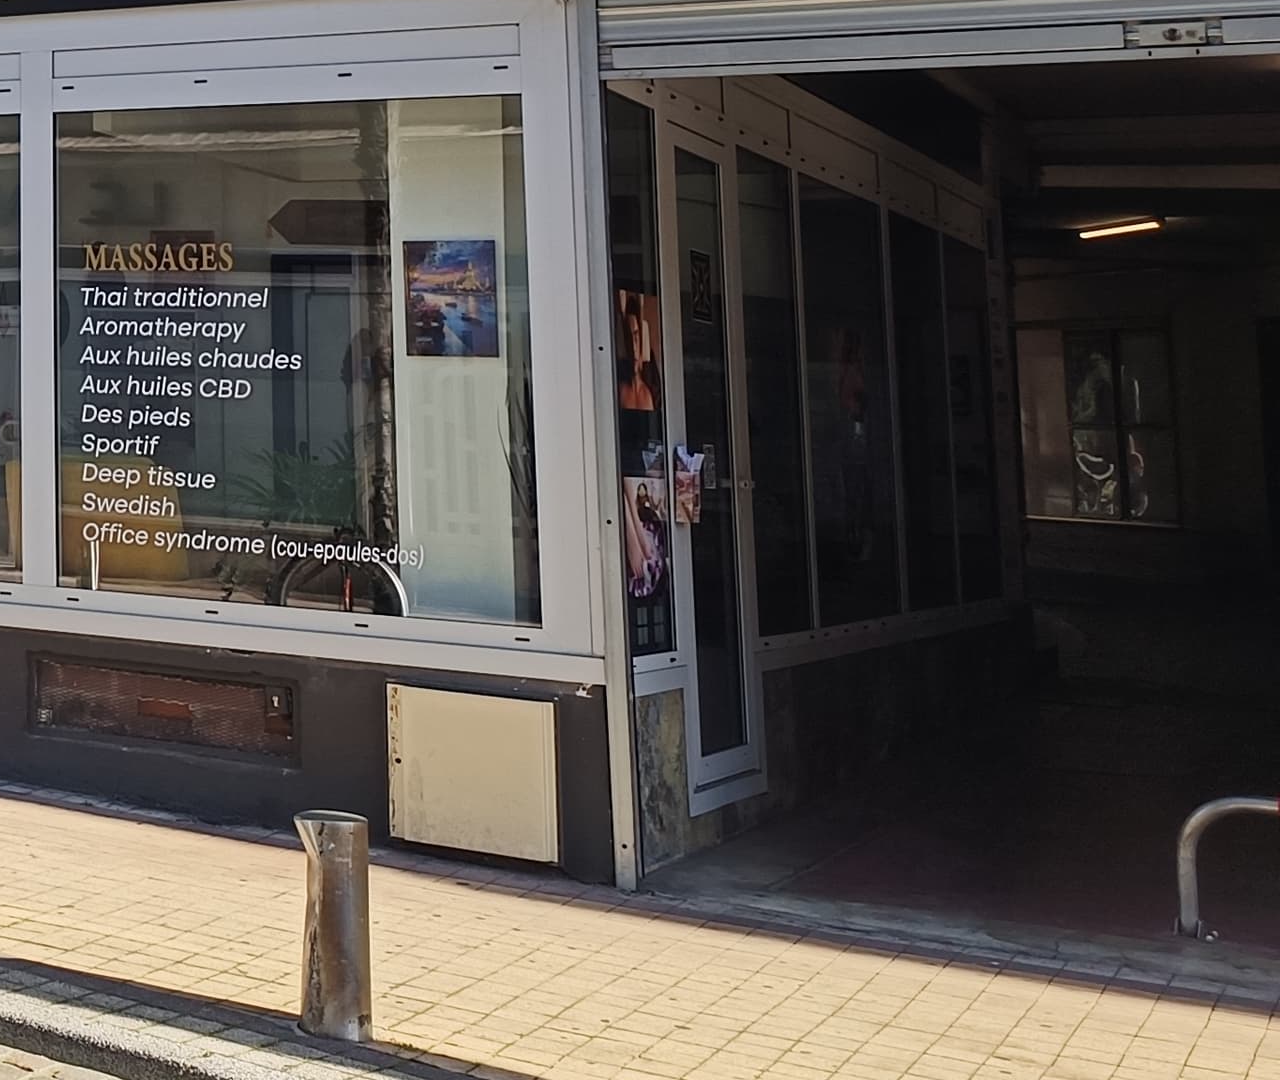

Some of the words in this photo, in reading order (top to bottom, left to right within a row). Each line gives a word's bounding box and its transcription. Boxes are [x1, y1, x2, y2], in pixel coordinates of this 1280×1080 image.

[83, 242, 233, 271] MASSAGES
[80, 286, 128, 307] Thai
[134, 287, 269, 308] traditionnel
[80, 317, 246, 343] Aromatherapy
[80, 346, 121, 365] Aux
[126, 346, 192, 367] huiles
[198, 348, 303, 369] chaudes
[80, 375, 121, 394] Aux
[126, 375, 193, 397] huiles
[199, 378, 252, 398] CBD
[81, 404, 123, 423] Des
[128, 405, 191, 429] pieds
[81, 433, 160, 457] Sportif
[82, 463, 140, 488] Deep
[147, 466, 216, 489] tissue
[82, 492, 175, 517] Swedish
[83, 522, 149, 545] Office
[154, 529, 265, 554] syndrome
[271, 534, 424, 569] (cou-epaules-dos)
